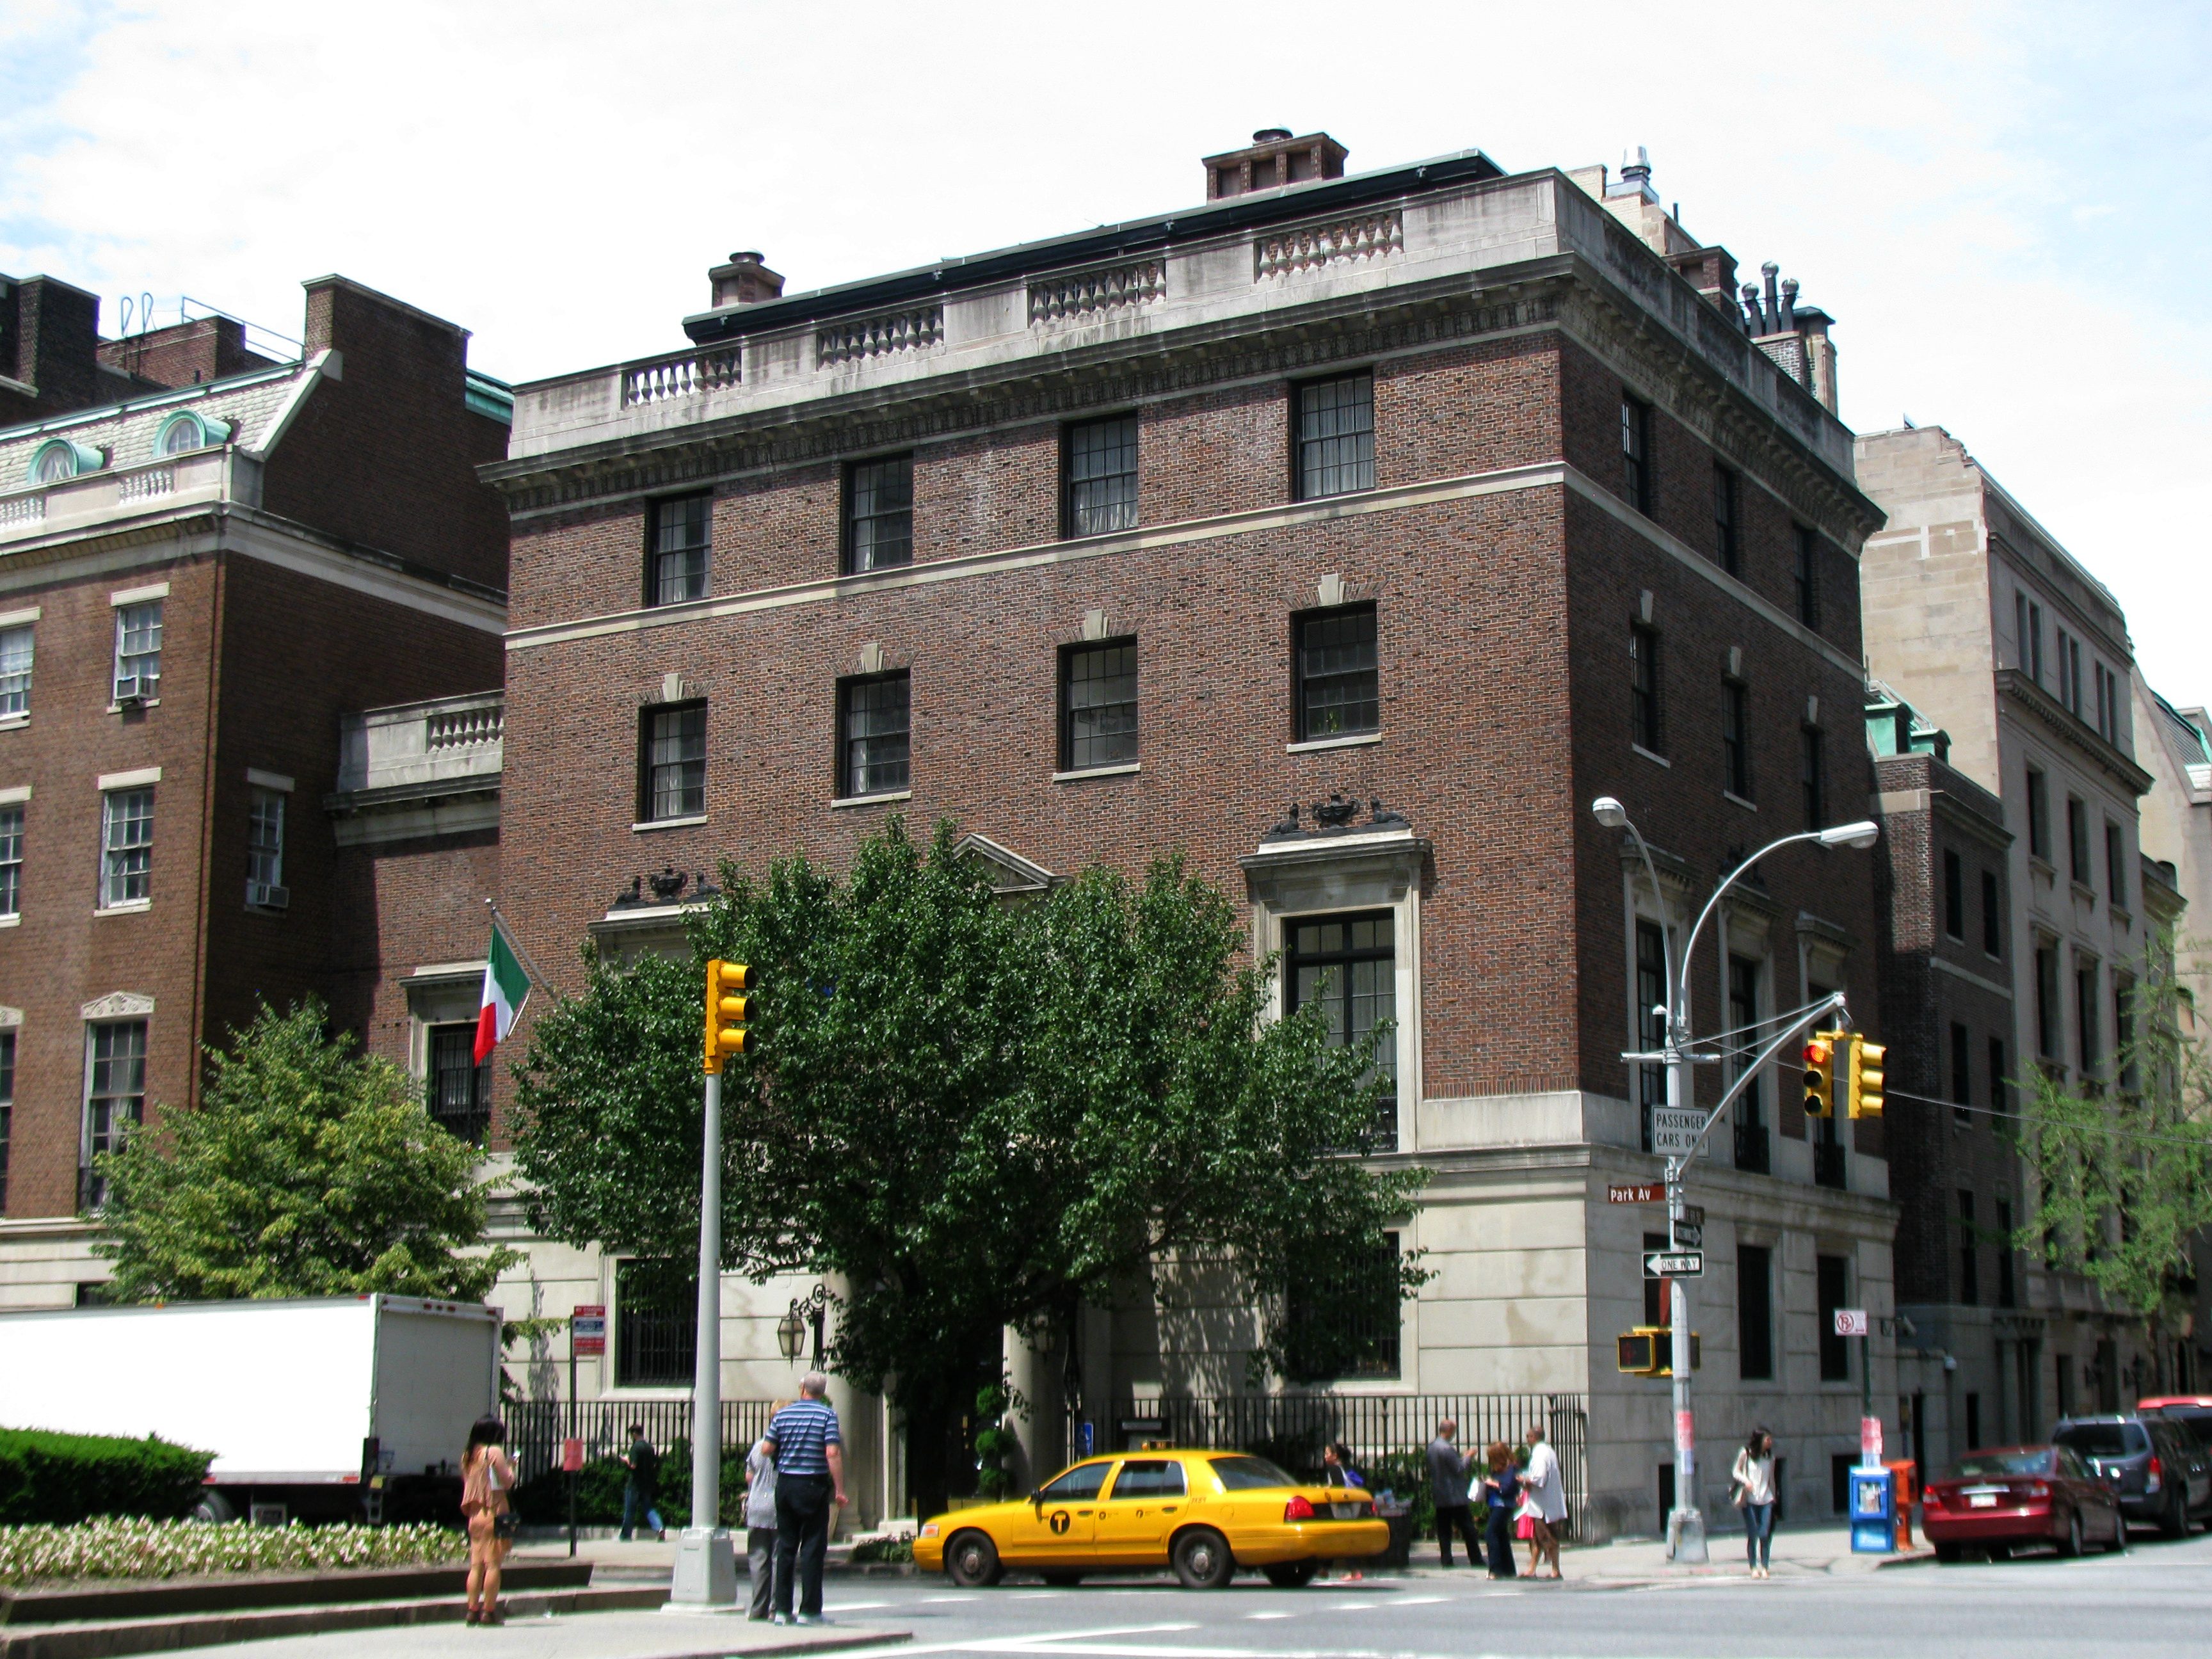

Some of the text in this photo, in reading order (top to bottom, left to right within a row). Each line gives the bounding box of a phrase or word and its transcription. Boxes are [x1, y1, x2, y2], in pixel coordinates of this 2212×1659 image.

[1656, 1114, 1706, 1129] PASSENGER
[1656, 1133, 1705, 1149] CARS ON
[1610, 1187, 1650, 1202] Park Av
[1662, 1259, 1697, 1270] ONE WAY
